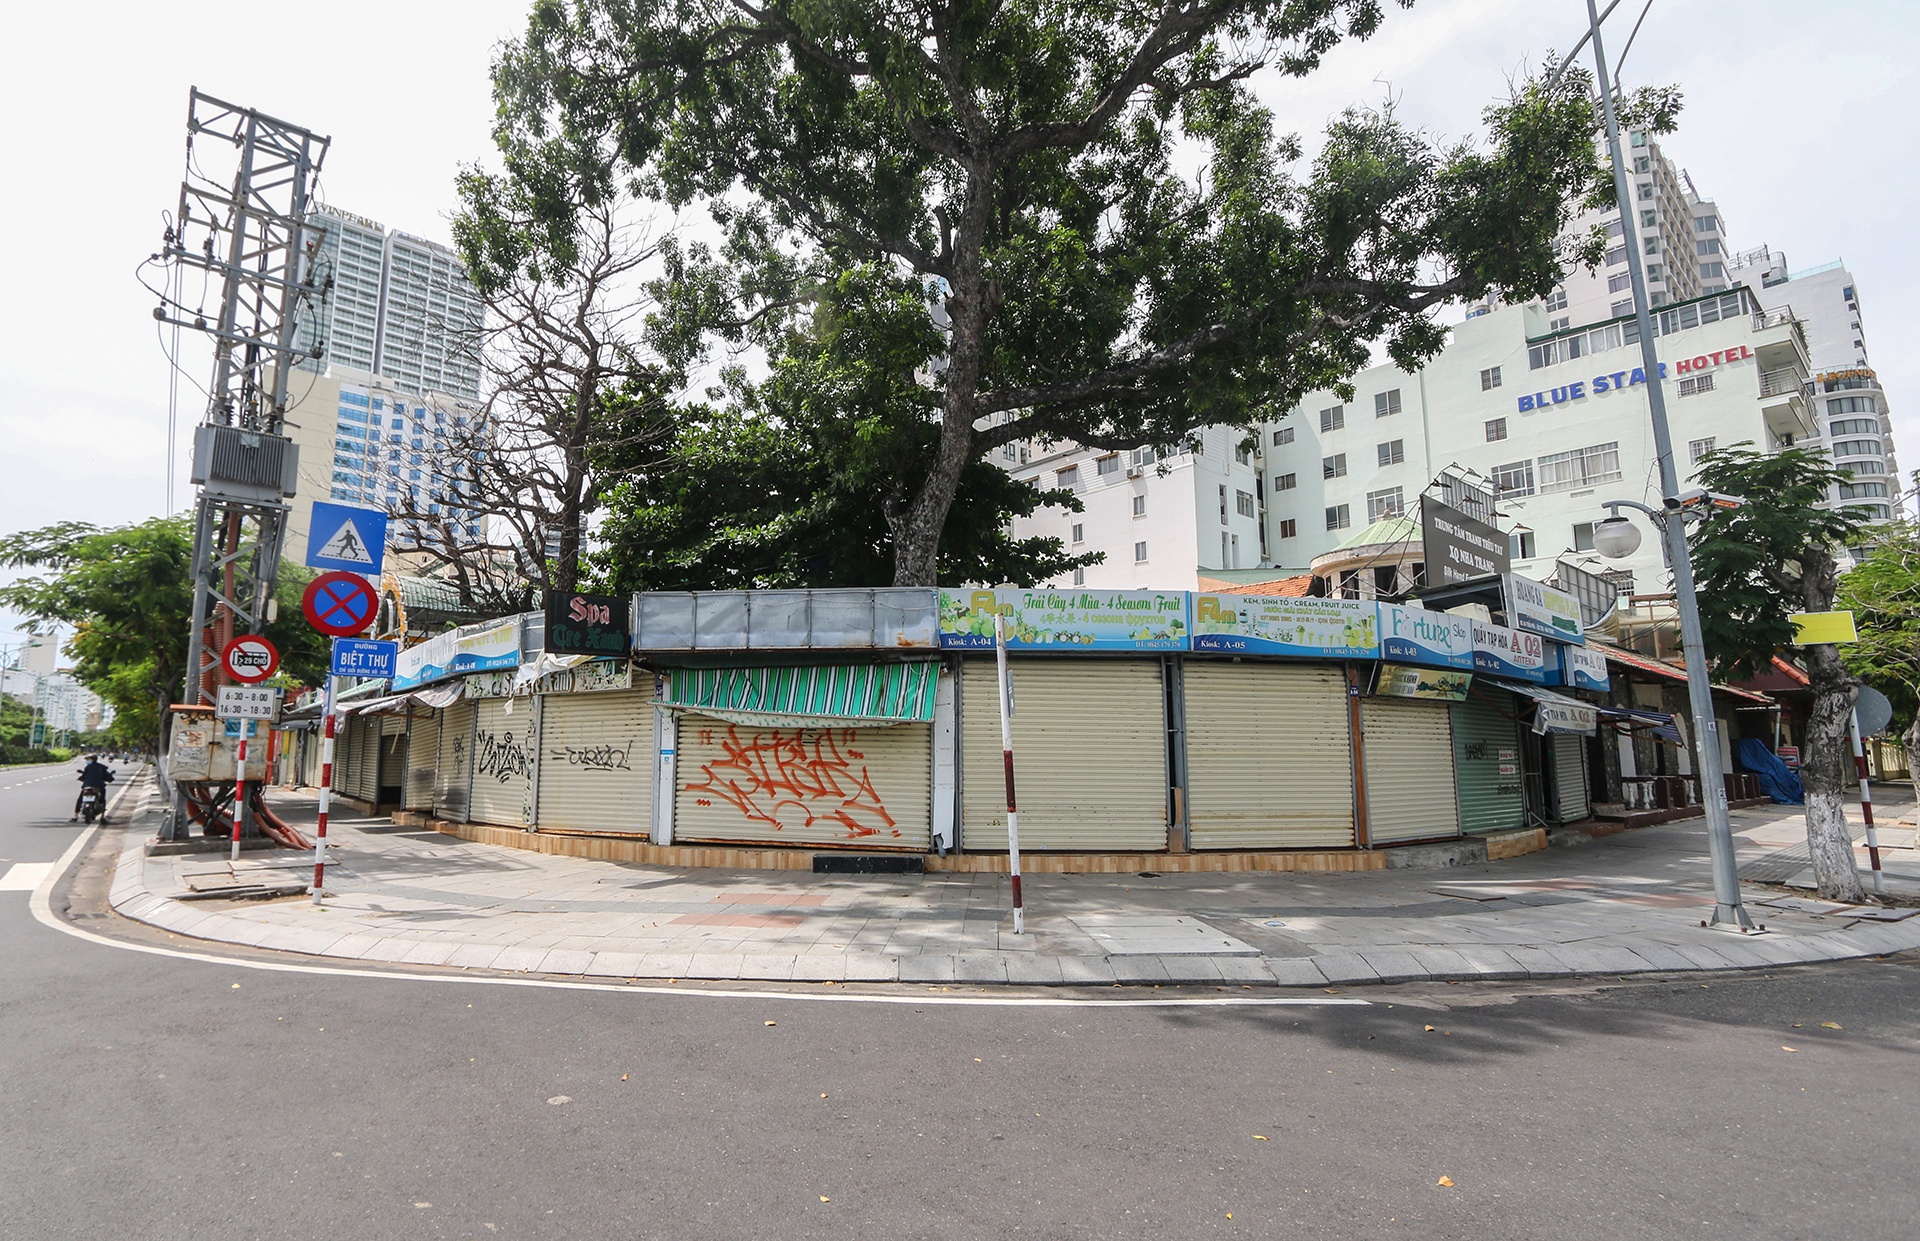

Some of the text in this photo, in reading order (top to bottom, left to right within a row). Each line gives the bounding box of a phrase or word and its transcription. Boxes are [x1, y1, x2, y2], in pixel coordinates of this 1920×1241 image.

[320, 202, 382, 232] VINPEARL
[1518, 381, 1585, 413] BLUE
[1676, 345, 1755, 375] HOTEL
[1434, 516, 1453, 535] TRUNG
[1465, 530, 1482, 547] TRANH
[1449, 544, 1495, 573] XQ NHA TRANG
[568, 596, 610, 627] Spa
[970, 590, 1013, 617] F4m
[1023, 592, 1046, 610] Trái
[1047, 593, 1067, 612] Cây
[1069, 595, 1076, 609] 4
[1077, 593, 1100, 610] Mùa
[1107, 595, 1114, 609] 4
[1115, 596, 1152, 611] Seasons
[1153, 594, 1182, 614] Fruit
[1197, 596, 1237, 625] F4m
[1261, 598, 1278, 606] SINH
[552, 623, 625, 652] Tre Xanh
[970, 638, 991, 646] A-04
[1223, 641, 1245, 649] A-05
[1510, 631, 1523, 654] A
[1524, 634, 1541, 659] 02
[340, 649, 389, 669] BIỆT THỰ
[220, 704, 241, 714] 16:30
[250, 706, 271, 715] 18:30
[225, 691, 243, 701] 6:30
[251, 692, 268, 702] 8:00
[1570, 708, 1578, 721] A
[1578, 710, 1590, 723] 02
